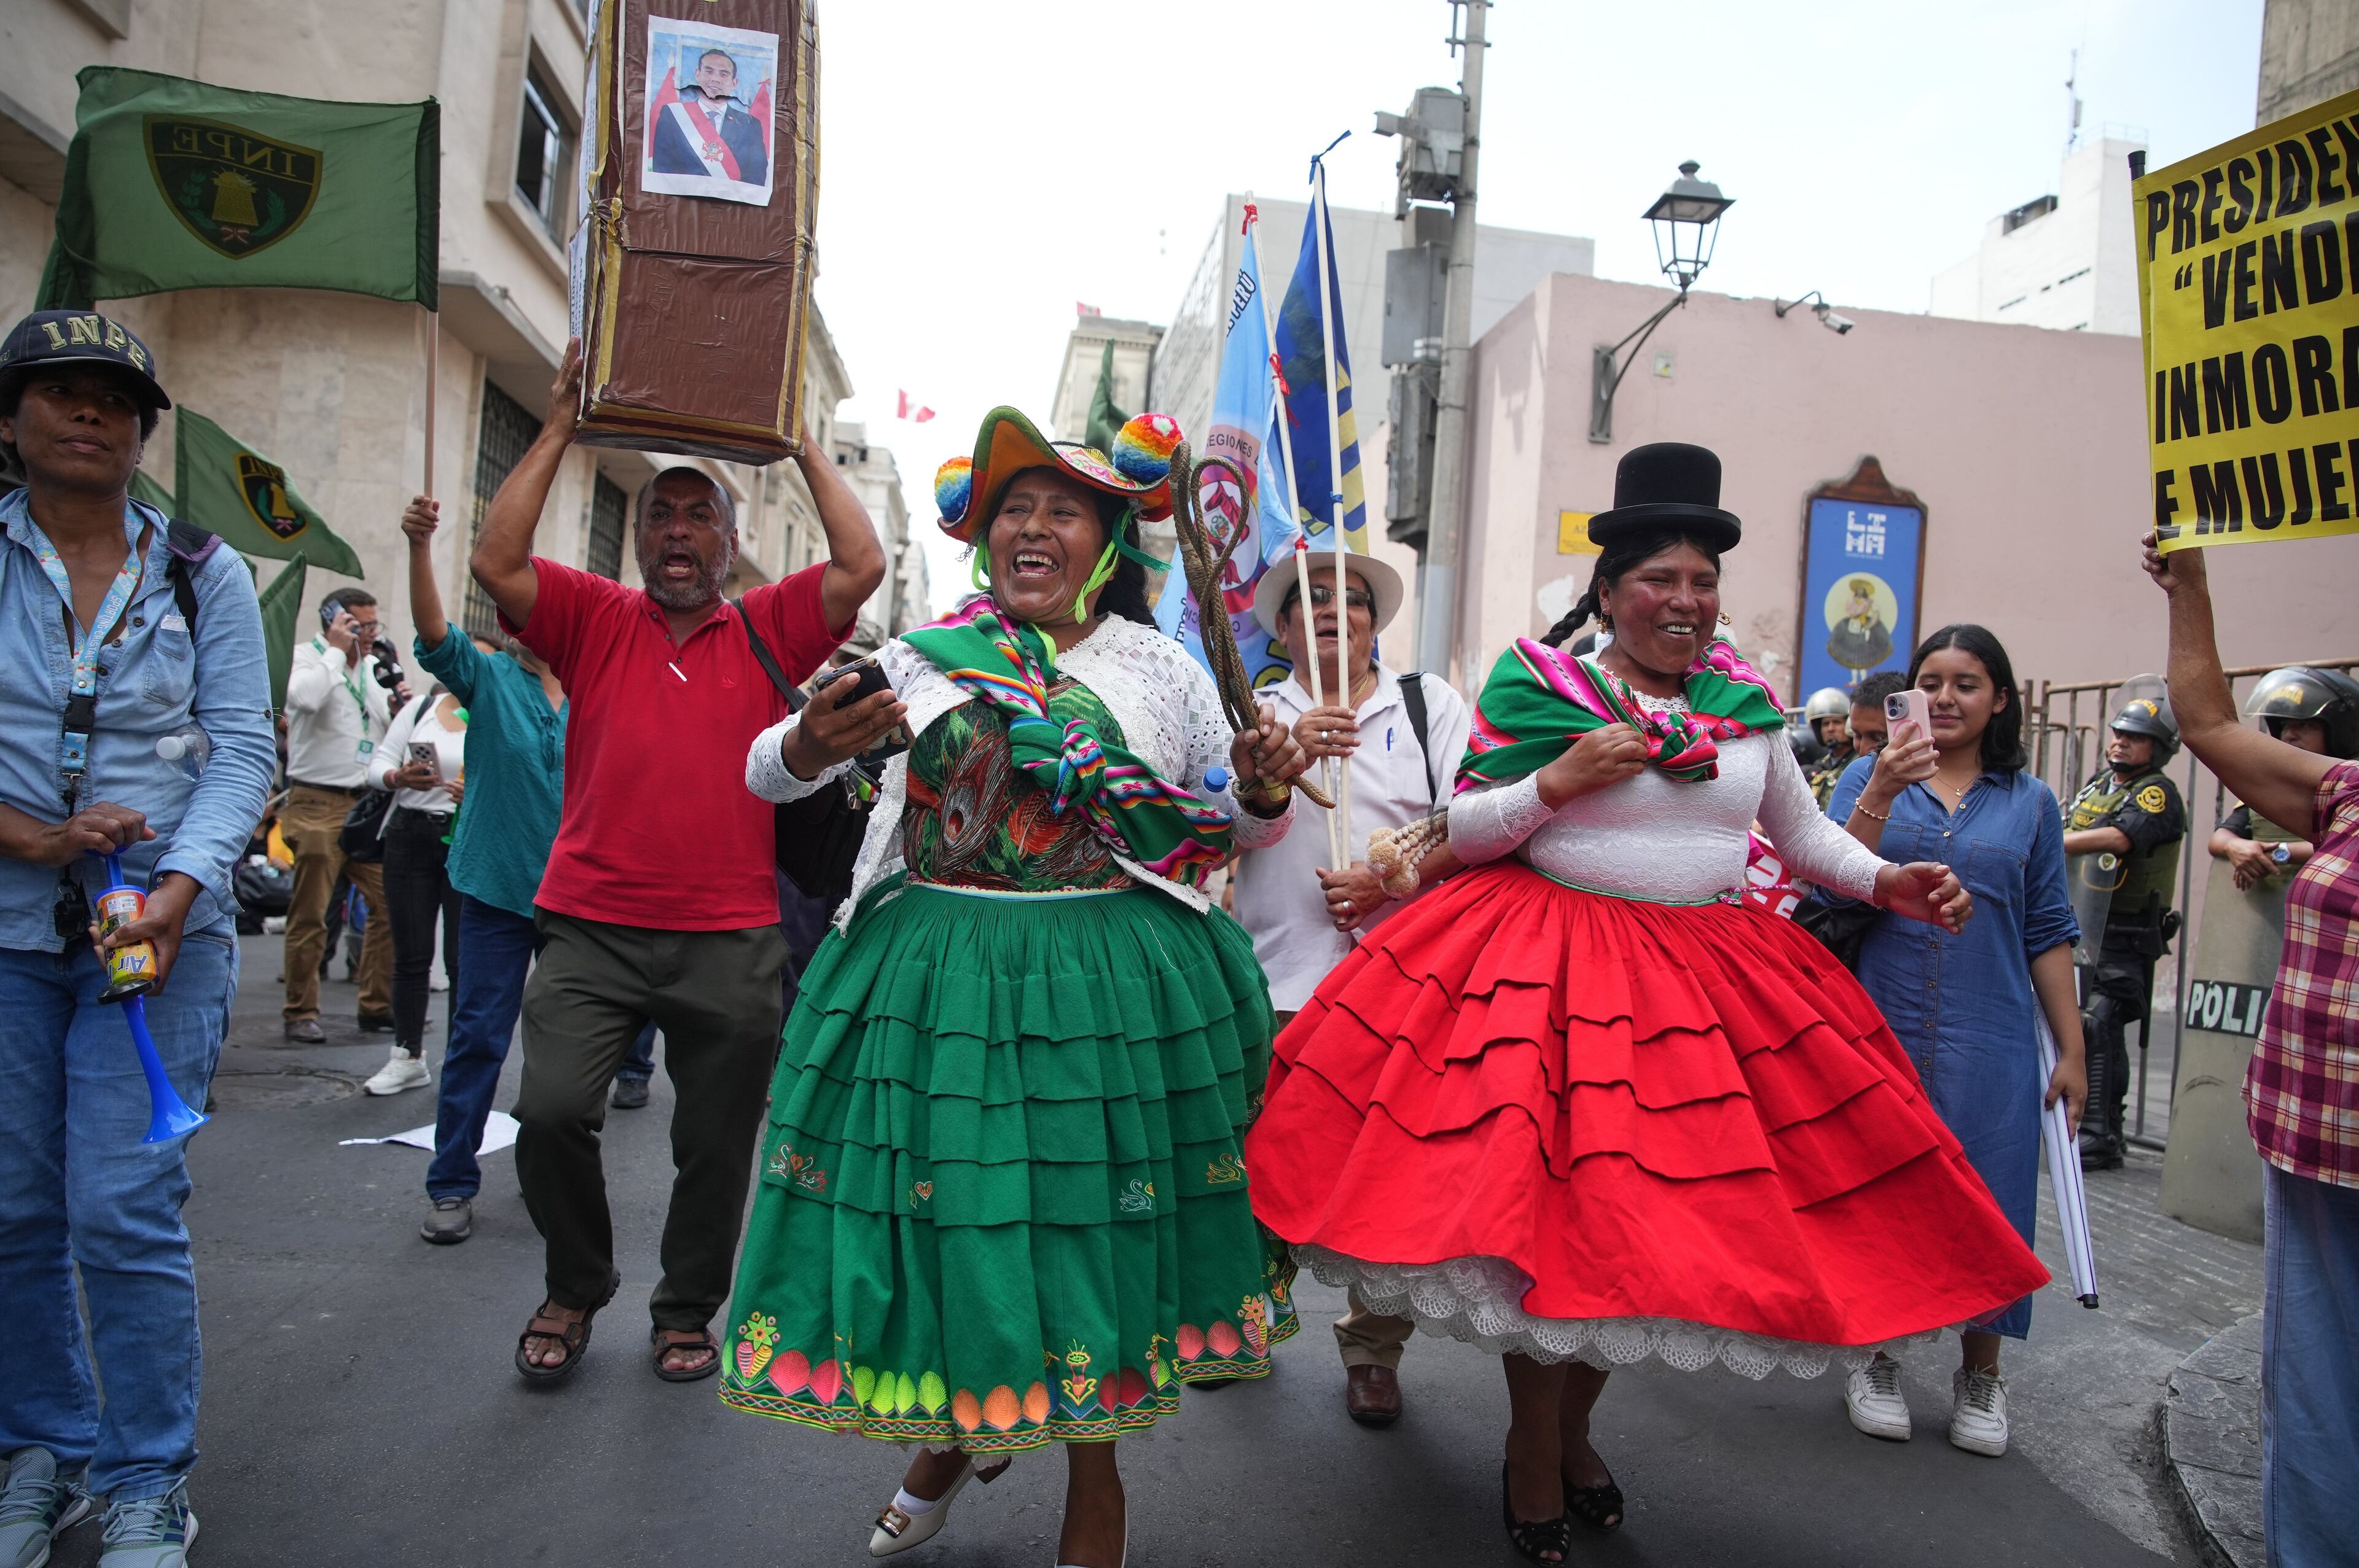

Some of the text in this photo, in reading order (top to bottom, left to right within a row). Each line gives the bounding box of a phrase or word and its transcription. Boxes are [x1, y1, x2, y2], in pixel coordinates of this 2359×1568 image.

[41, 314, 146, 372] INPE
[1207, 434, 1253, 458] EGIONES
[2156, 438, 2359, 542] E MUJE
[117, 954, 148, 973] Air
